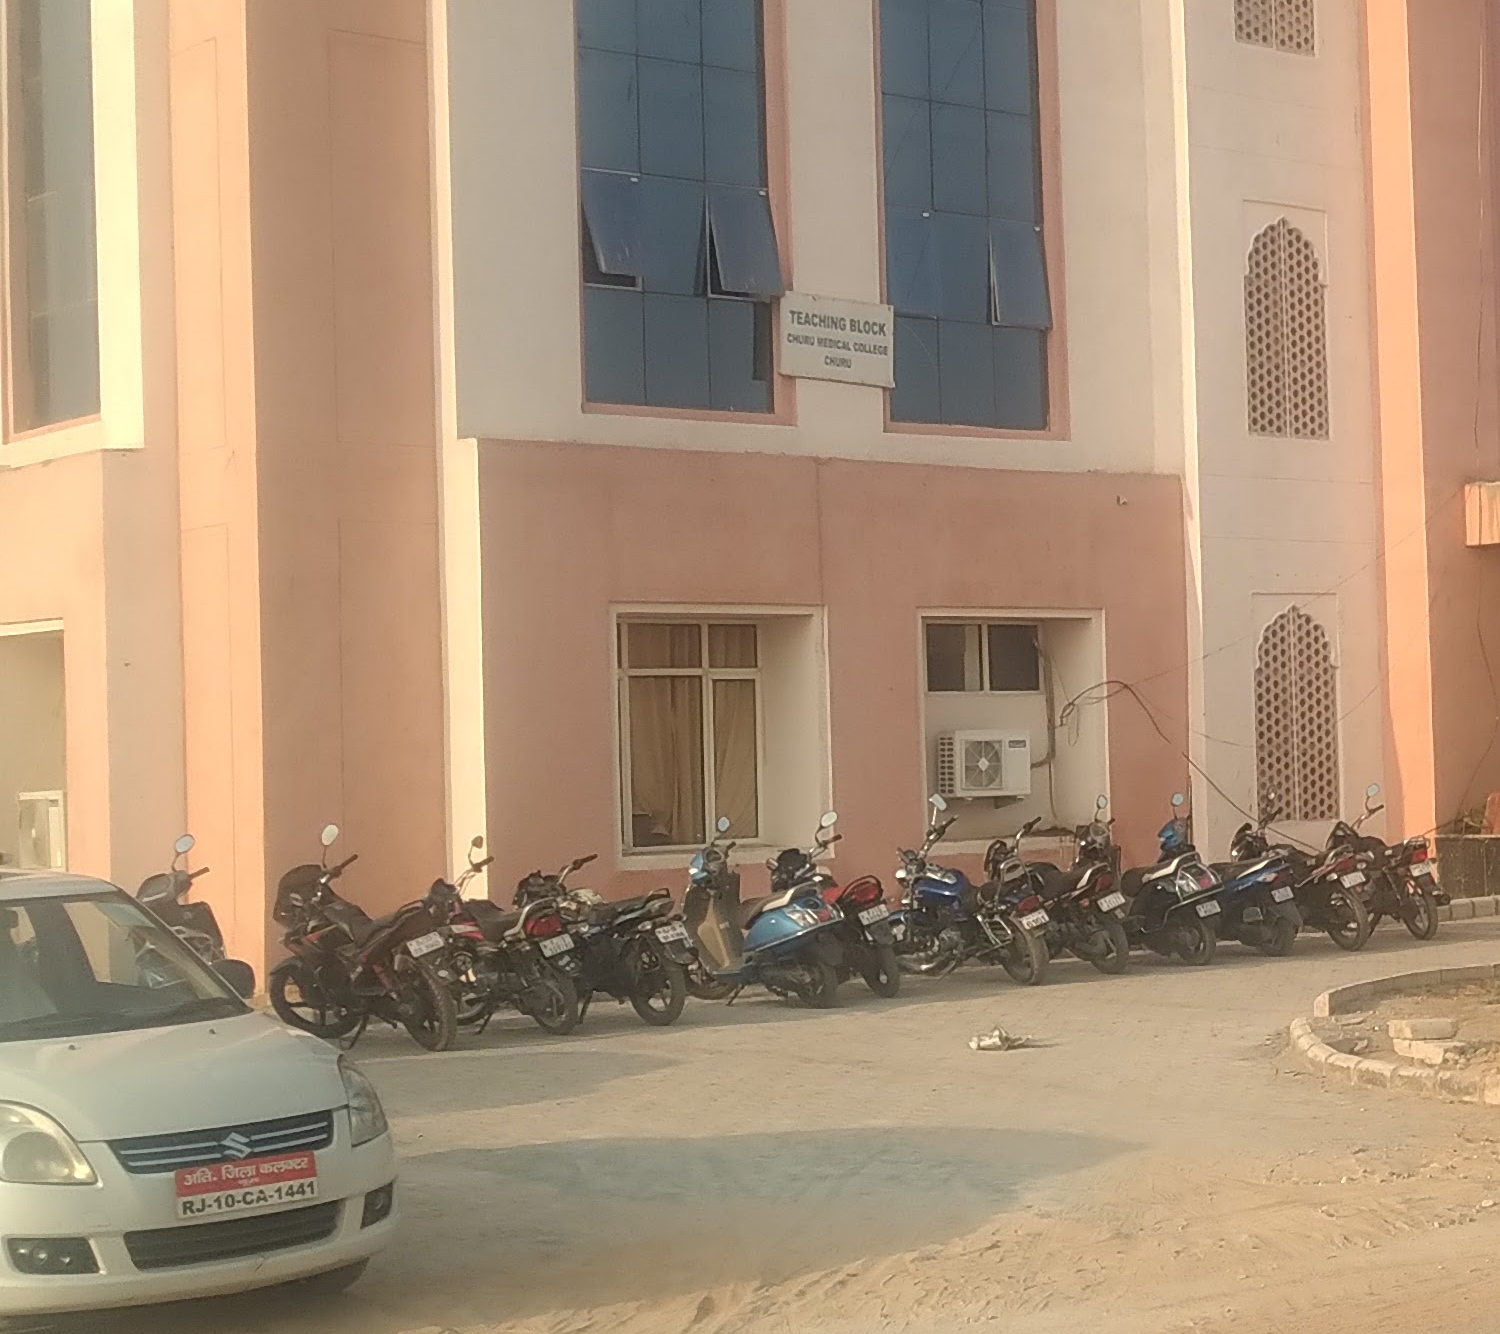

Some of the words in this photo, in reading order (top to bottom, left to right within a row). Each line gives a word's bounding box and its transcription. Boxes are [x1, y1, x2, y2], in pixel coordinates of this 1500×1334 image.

[789, 310, 847, 331] TEACHING
[850, 318, 886, 336] BLOCK
[787, 333, 815, 346] CHURU
[817, 337, 852, 351] MEDICAL
[853, 343, 888, 356] COLLEGE
[824, 355, 852, 369] CHURU
[183, 1168, 217, 1186] अति.
[222, 1164, 256, 1180] जिला
[182, 1180, 315, 1215] RJ-10-CA-1441
